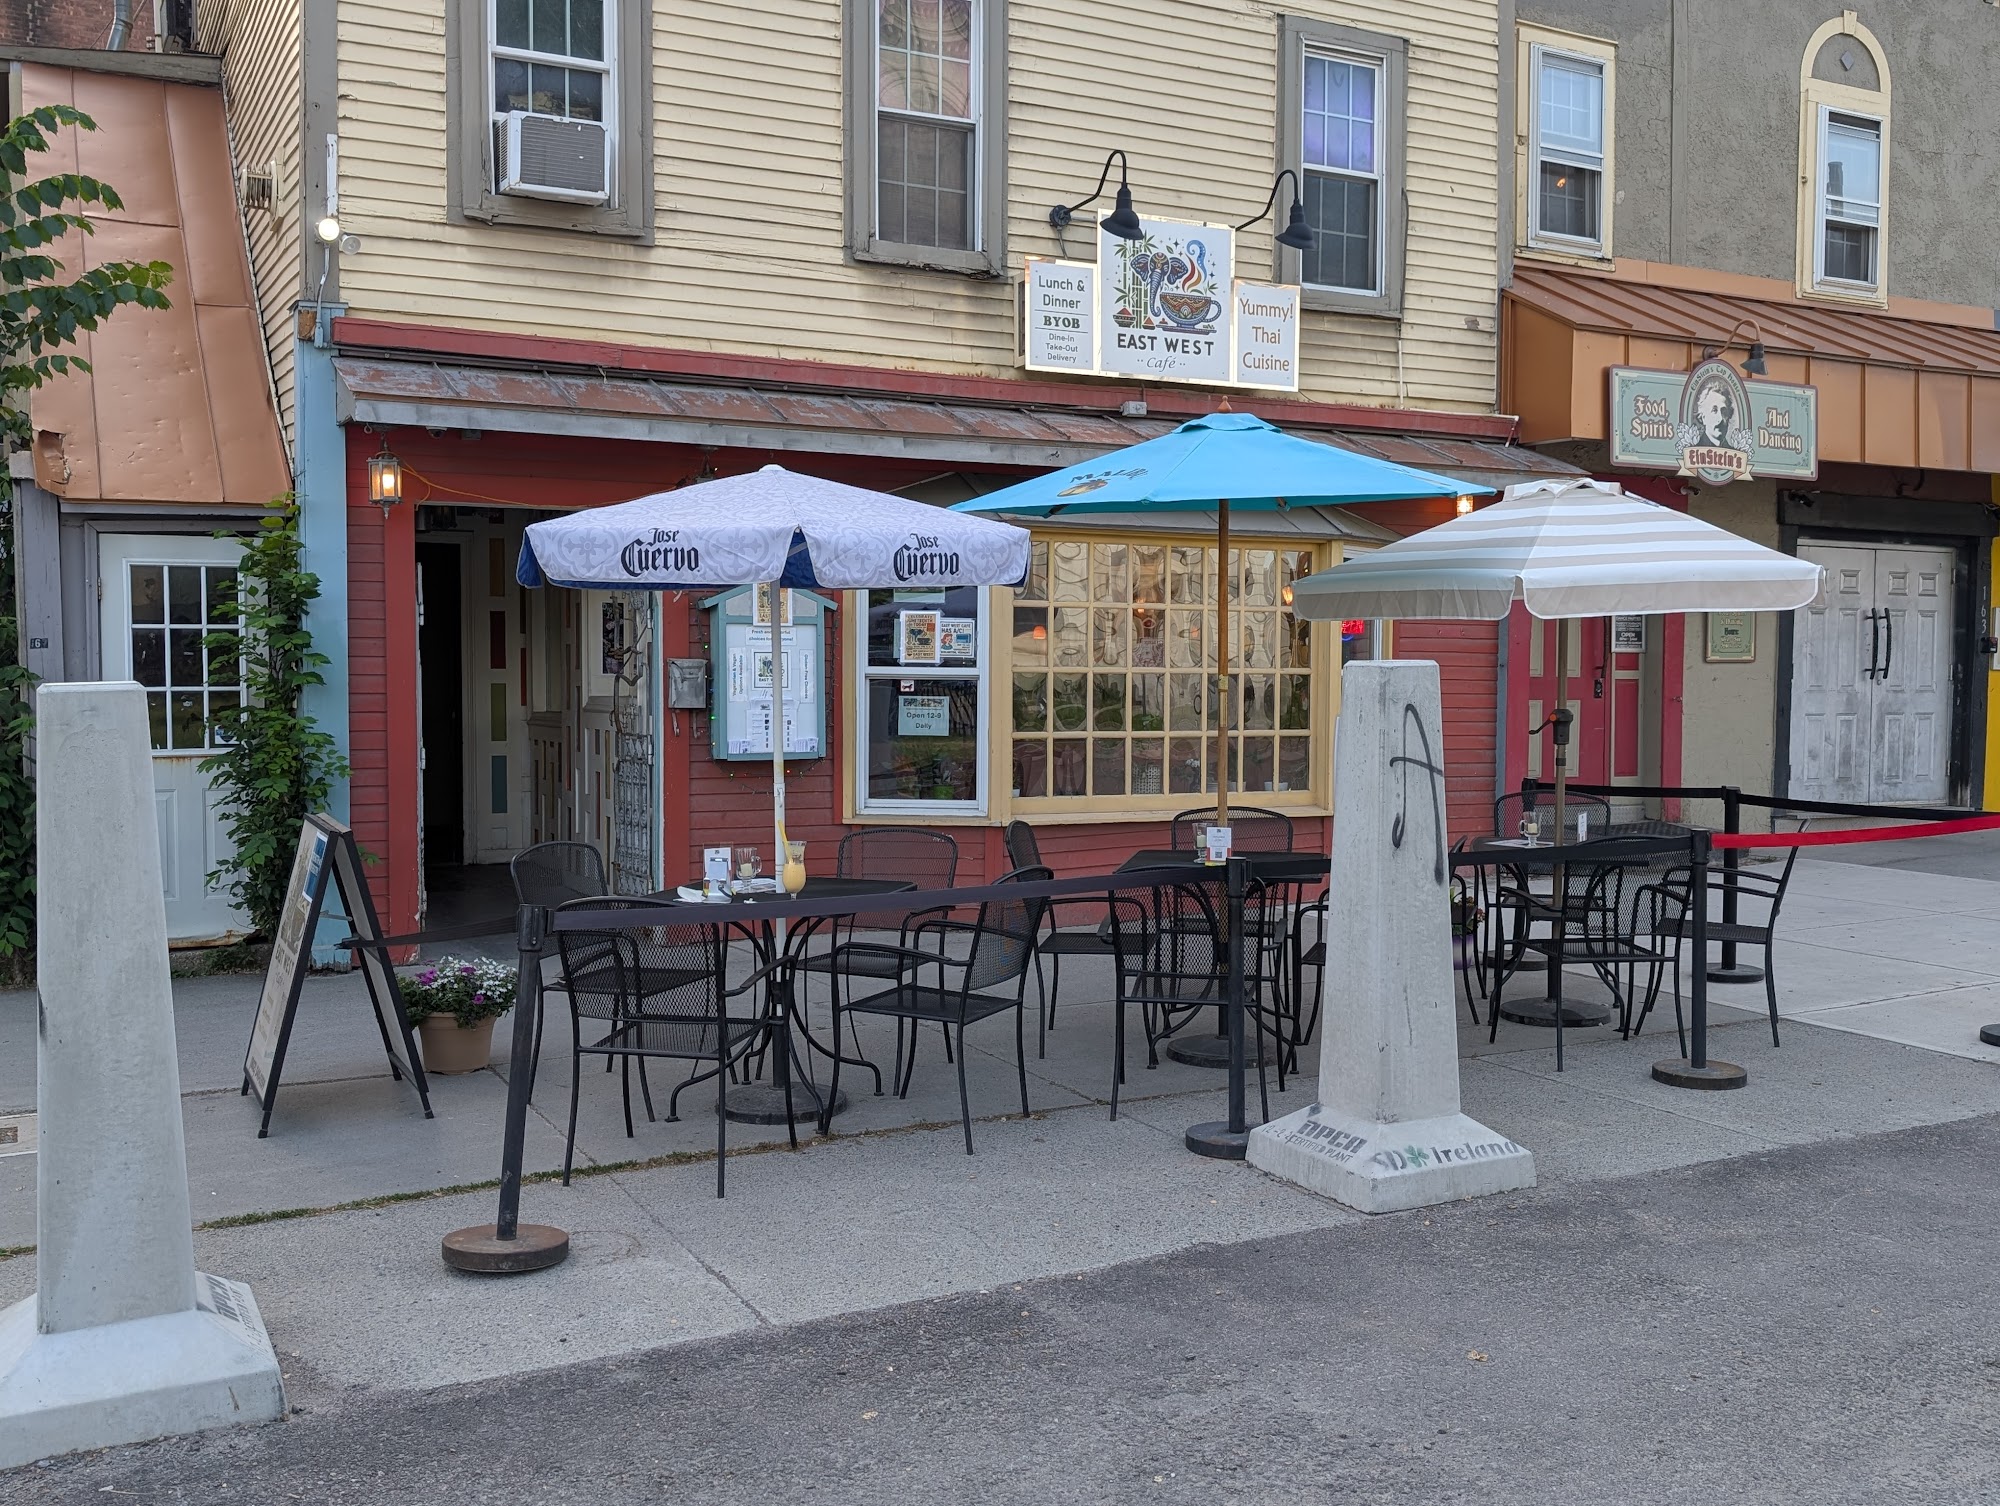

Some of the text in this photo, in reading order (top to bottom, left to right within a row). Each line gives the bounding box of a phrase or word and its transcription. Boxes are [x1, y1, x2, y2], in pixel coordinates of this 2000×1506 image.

[1038, 275, 1085, 292] Lunch &
[1043, 293, 1081, 310] Dinner
[1240, 298, 1294, 322] Yummy!
[1043, 315, 1080, 329] BYOB
[1049, 333, 1075, 343] Dine-In
[1118, 333, 1214, 356] EAST WEST
[1252, 327, 1281, 345] Thai
[1046, 343, 1078, 353] Take-Out
[1047, 353, 1077, 364] Delivery
[1147, 356, 1176, 372] Café
[1243, 352, 1290, 372] Cuisine
[1635, 395, 1670, 419] Food,
[1766, 407, 1790, 429] And
[1632, 418, 1675, 440] Spirits
[1758, 427, 1802, 454] Dancing
[647, 527, 680, 545] Jose
[910, 533, 938, 552] Jose
[621, 539, 699, 577] Cuervo
[893, 544, 959, 582] Cuervo
[1288, 1134, 1354, 1163] CERTIFIED PLANT
[1430, 1141, 1520, 1164] Ireland
